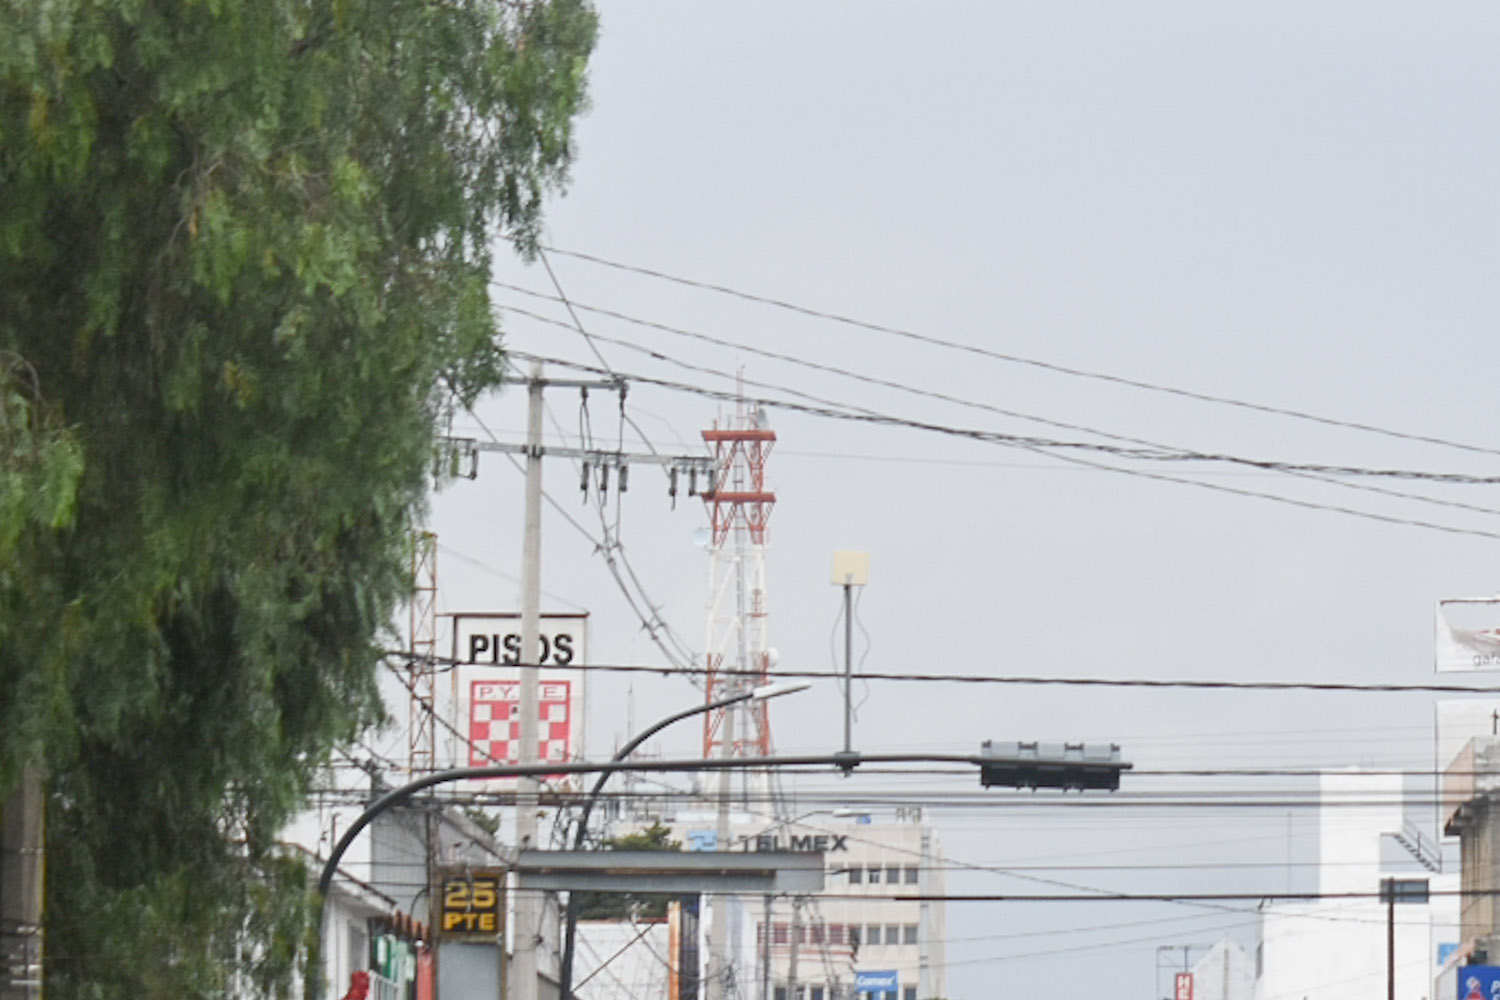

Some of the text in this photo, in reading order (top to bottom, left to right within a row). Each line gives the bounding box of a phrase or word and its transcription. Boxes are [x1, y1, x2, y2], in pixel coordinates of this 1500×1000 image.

[739, 834, 849, 851] TELMEX
[444, 881, 497, 908] 25
[443, 912, 496, 931] PTE
